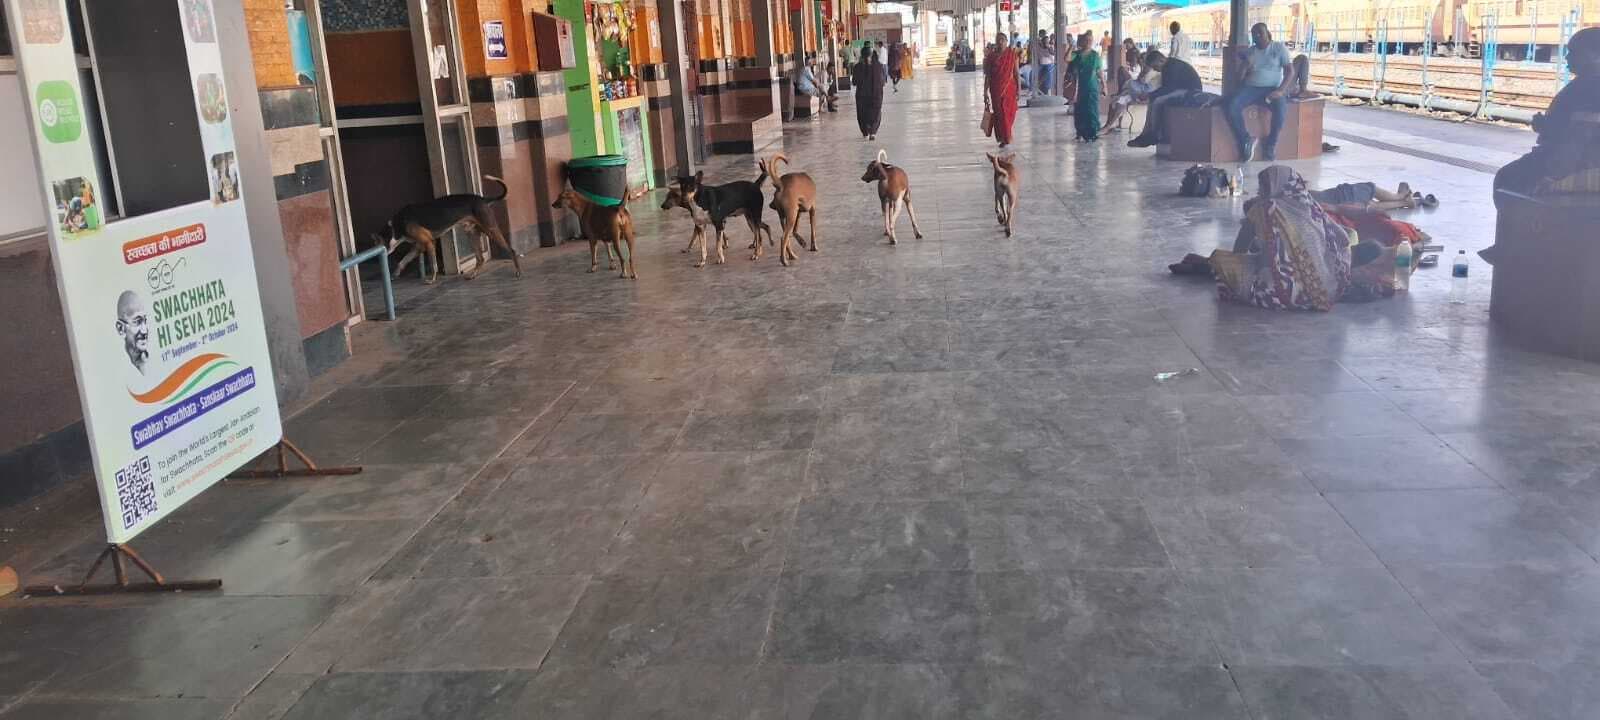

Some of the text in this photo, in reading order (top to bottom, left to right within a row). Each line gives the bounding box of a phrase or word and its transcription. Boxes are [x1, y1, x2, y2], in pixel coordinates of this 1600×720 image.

[126, 243, 158, 261] स्वच्छता
[158, 236, 170, 251] की
[153, 279, 226, 323] SWACHHATA
[157, 300, 235, 348] HI SEVA 2024
[171, 339, 198, 359] September
[134, 420, 164, 445] Swabhav
[164, 402, 197, 429] Swachhata
[225, 372, 254, 397] Swachhata
[158, 460, 166, 470] To
[166, 454, 177, 468] join
[178, 447, 188, 459] the
